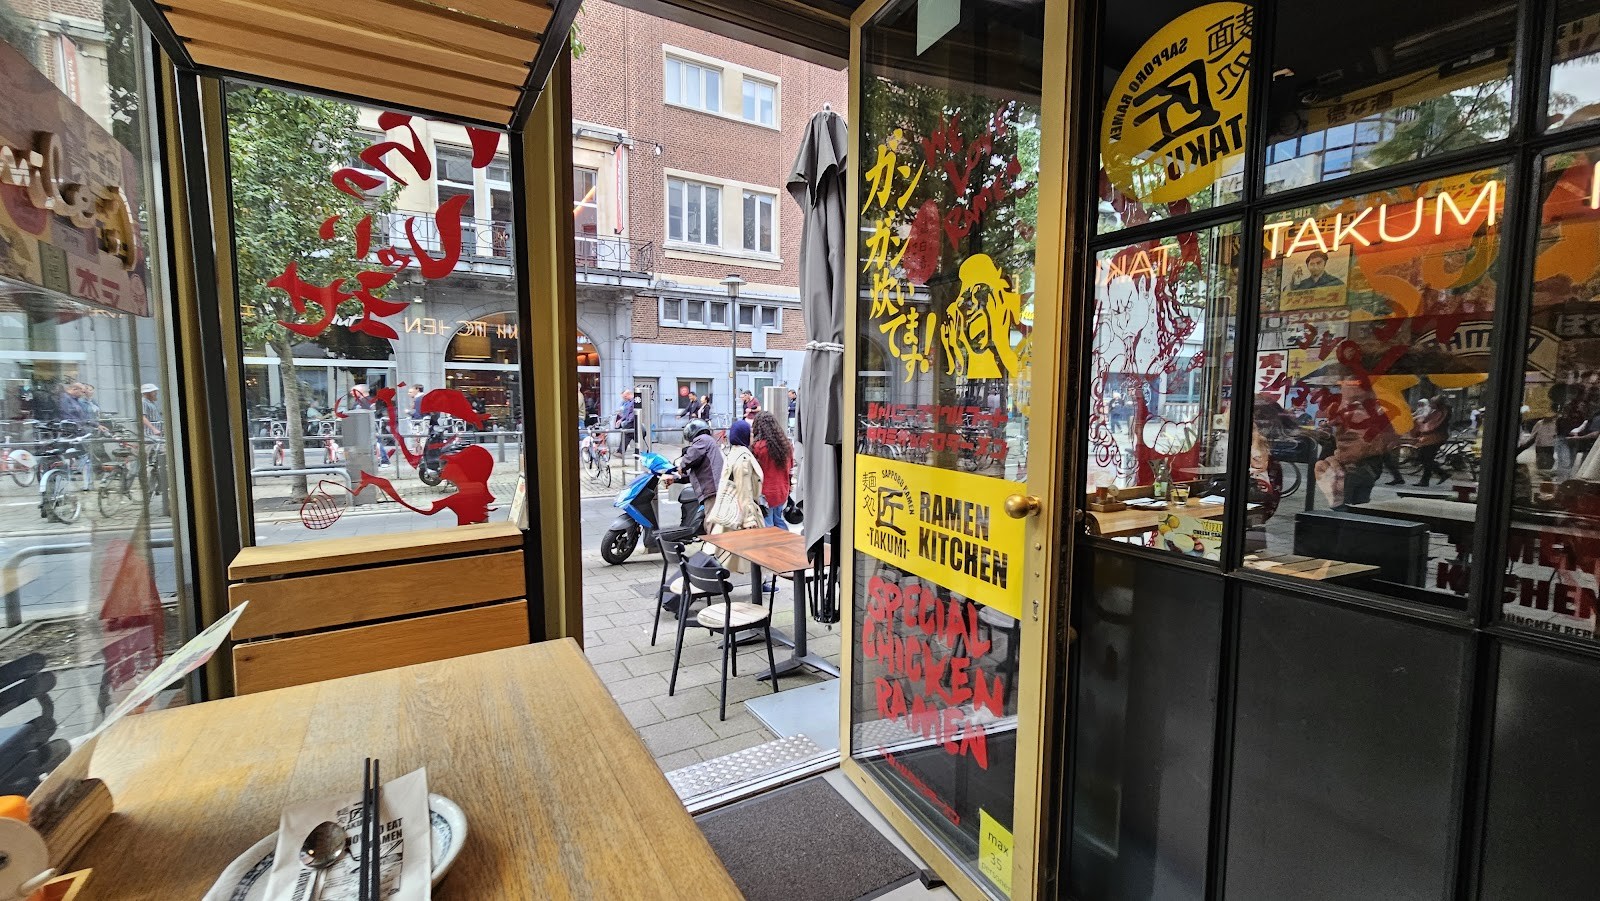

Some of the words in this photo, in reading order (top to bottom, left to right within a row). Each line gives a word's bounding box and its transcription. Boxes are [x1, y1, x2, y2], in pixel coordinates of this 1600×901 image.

[1263, 180, 1498, 260] TAKUM
[1288, 310, 1351, 323] SANYO
[881, 469, 905, 488] SAPPORO
[919, 491, 990, 542] RAMEN
[918, 526, 1008, 590] KITCHEN
[867, 576, 991, 659] SPECIAL
[862, 617, 1005, 718] CHICKEN
[874, 676, 988, 771] RAMEN
[381, 829, 404, 845] MEN
[386, 817, 404, 831] EAT
[988, 831, 1009, 857] max
[990, 852, 1003, 871] 35
